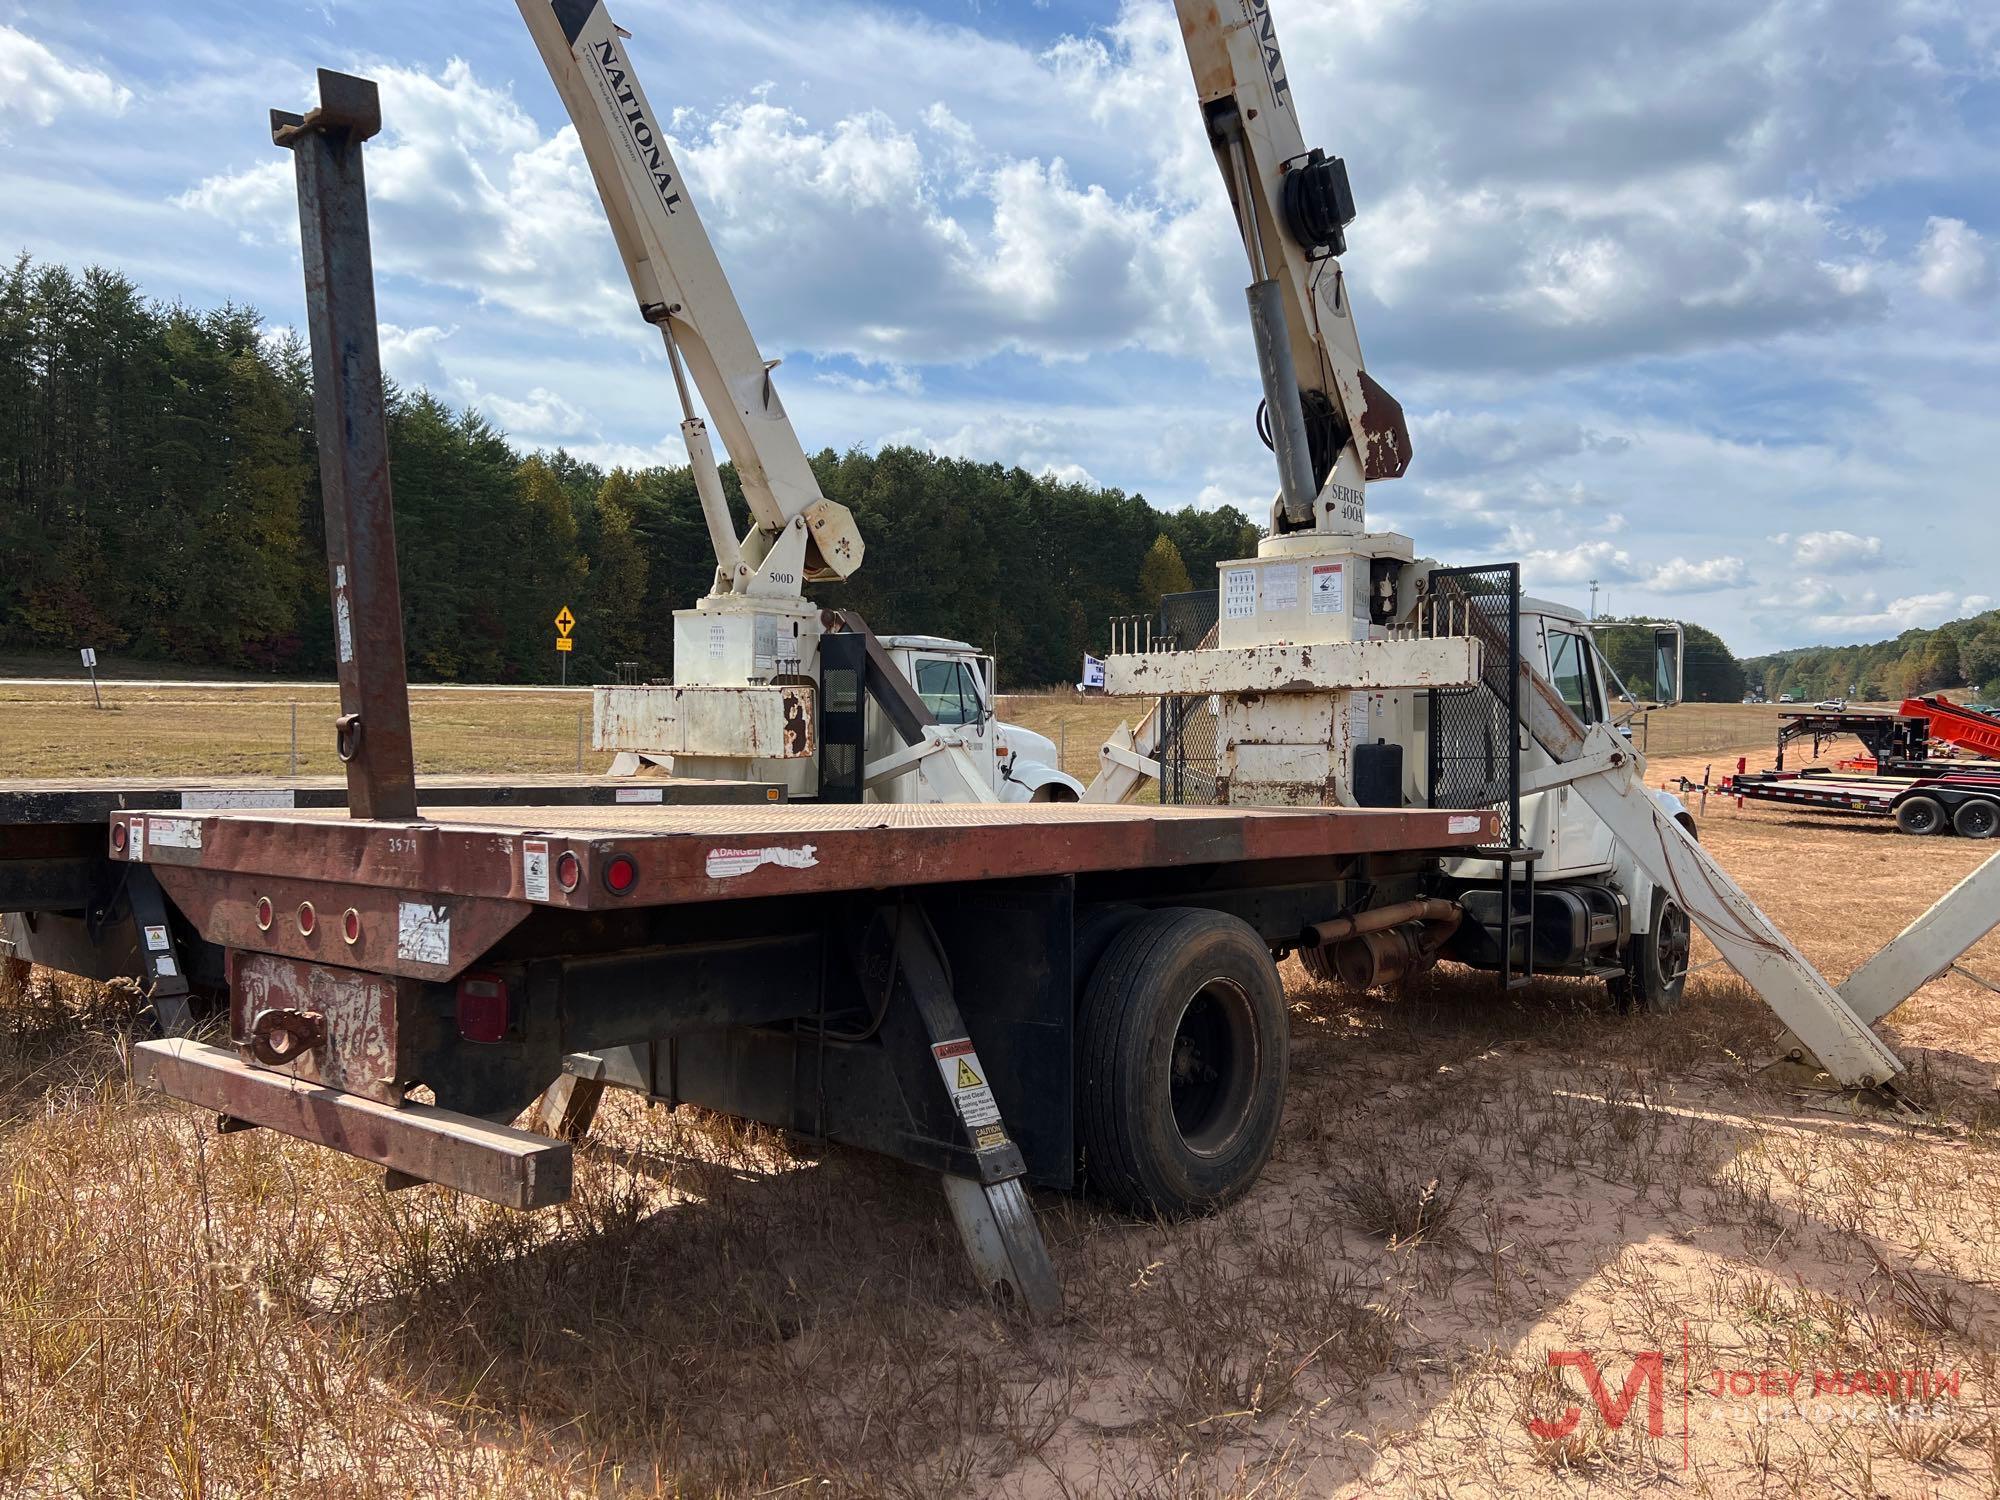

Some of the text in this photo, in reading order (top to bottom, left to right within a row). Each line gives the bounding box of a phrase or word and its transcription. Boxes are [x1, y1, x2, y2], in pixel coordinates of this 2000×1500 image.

[594, 38, 682, 215] NATIONAL
[619, 124, 637, 162] Company
[1332, 484, 1364, 507] SERIES
[1342, 502, 1364, 523] 400A
[770, 572, 794, 584] 500D
[975, 1125, 1001, 1137] CAUTION
